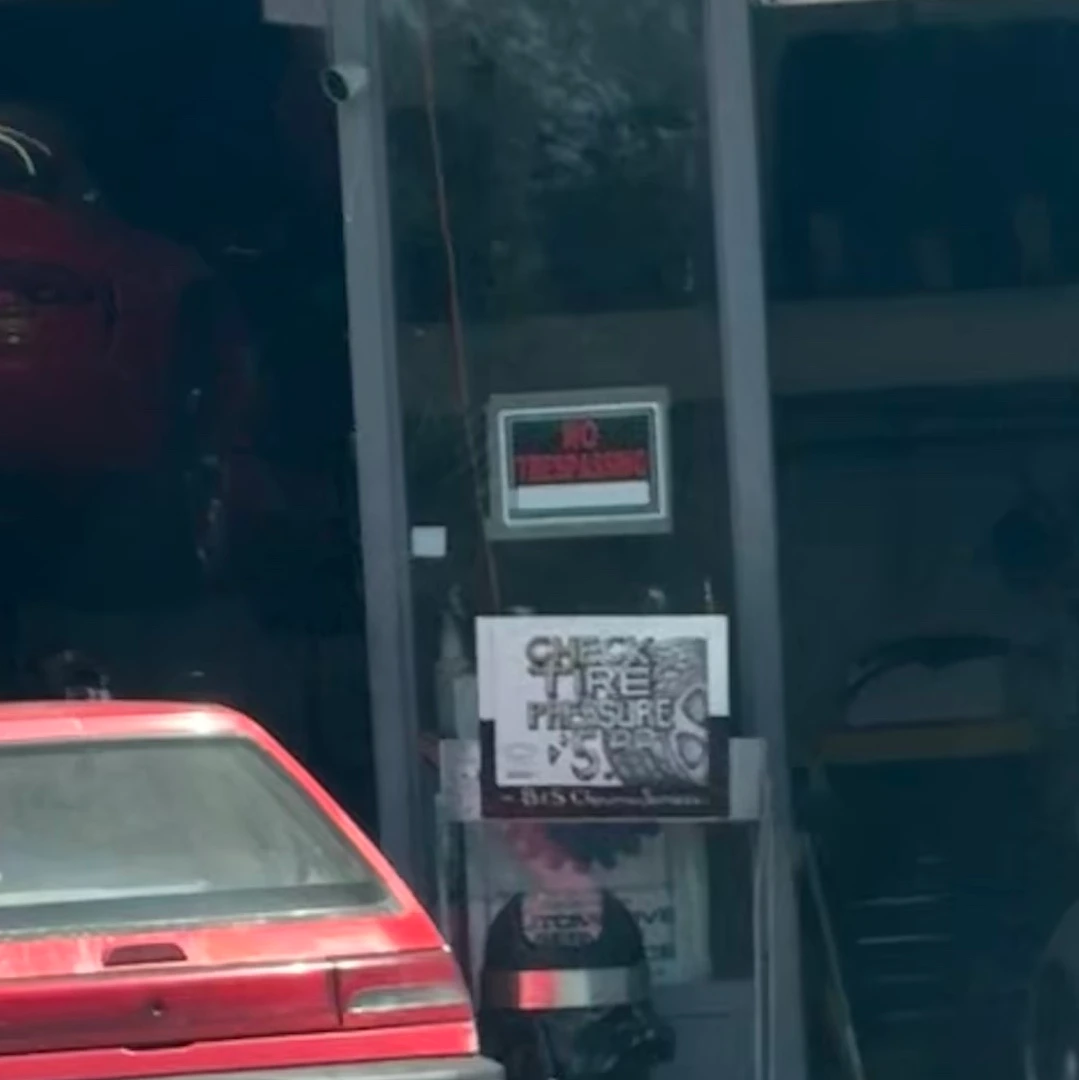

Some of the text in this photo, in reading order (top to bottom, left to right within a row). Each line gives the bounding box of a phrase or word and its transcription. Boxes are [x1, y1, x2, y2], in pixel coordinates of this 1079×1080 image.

[526, 635, 655, 667] CHECK
[527, 664, 654, 699] TIRE
[526, 699, 677, 731] PRESSURE
